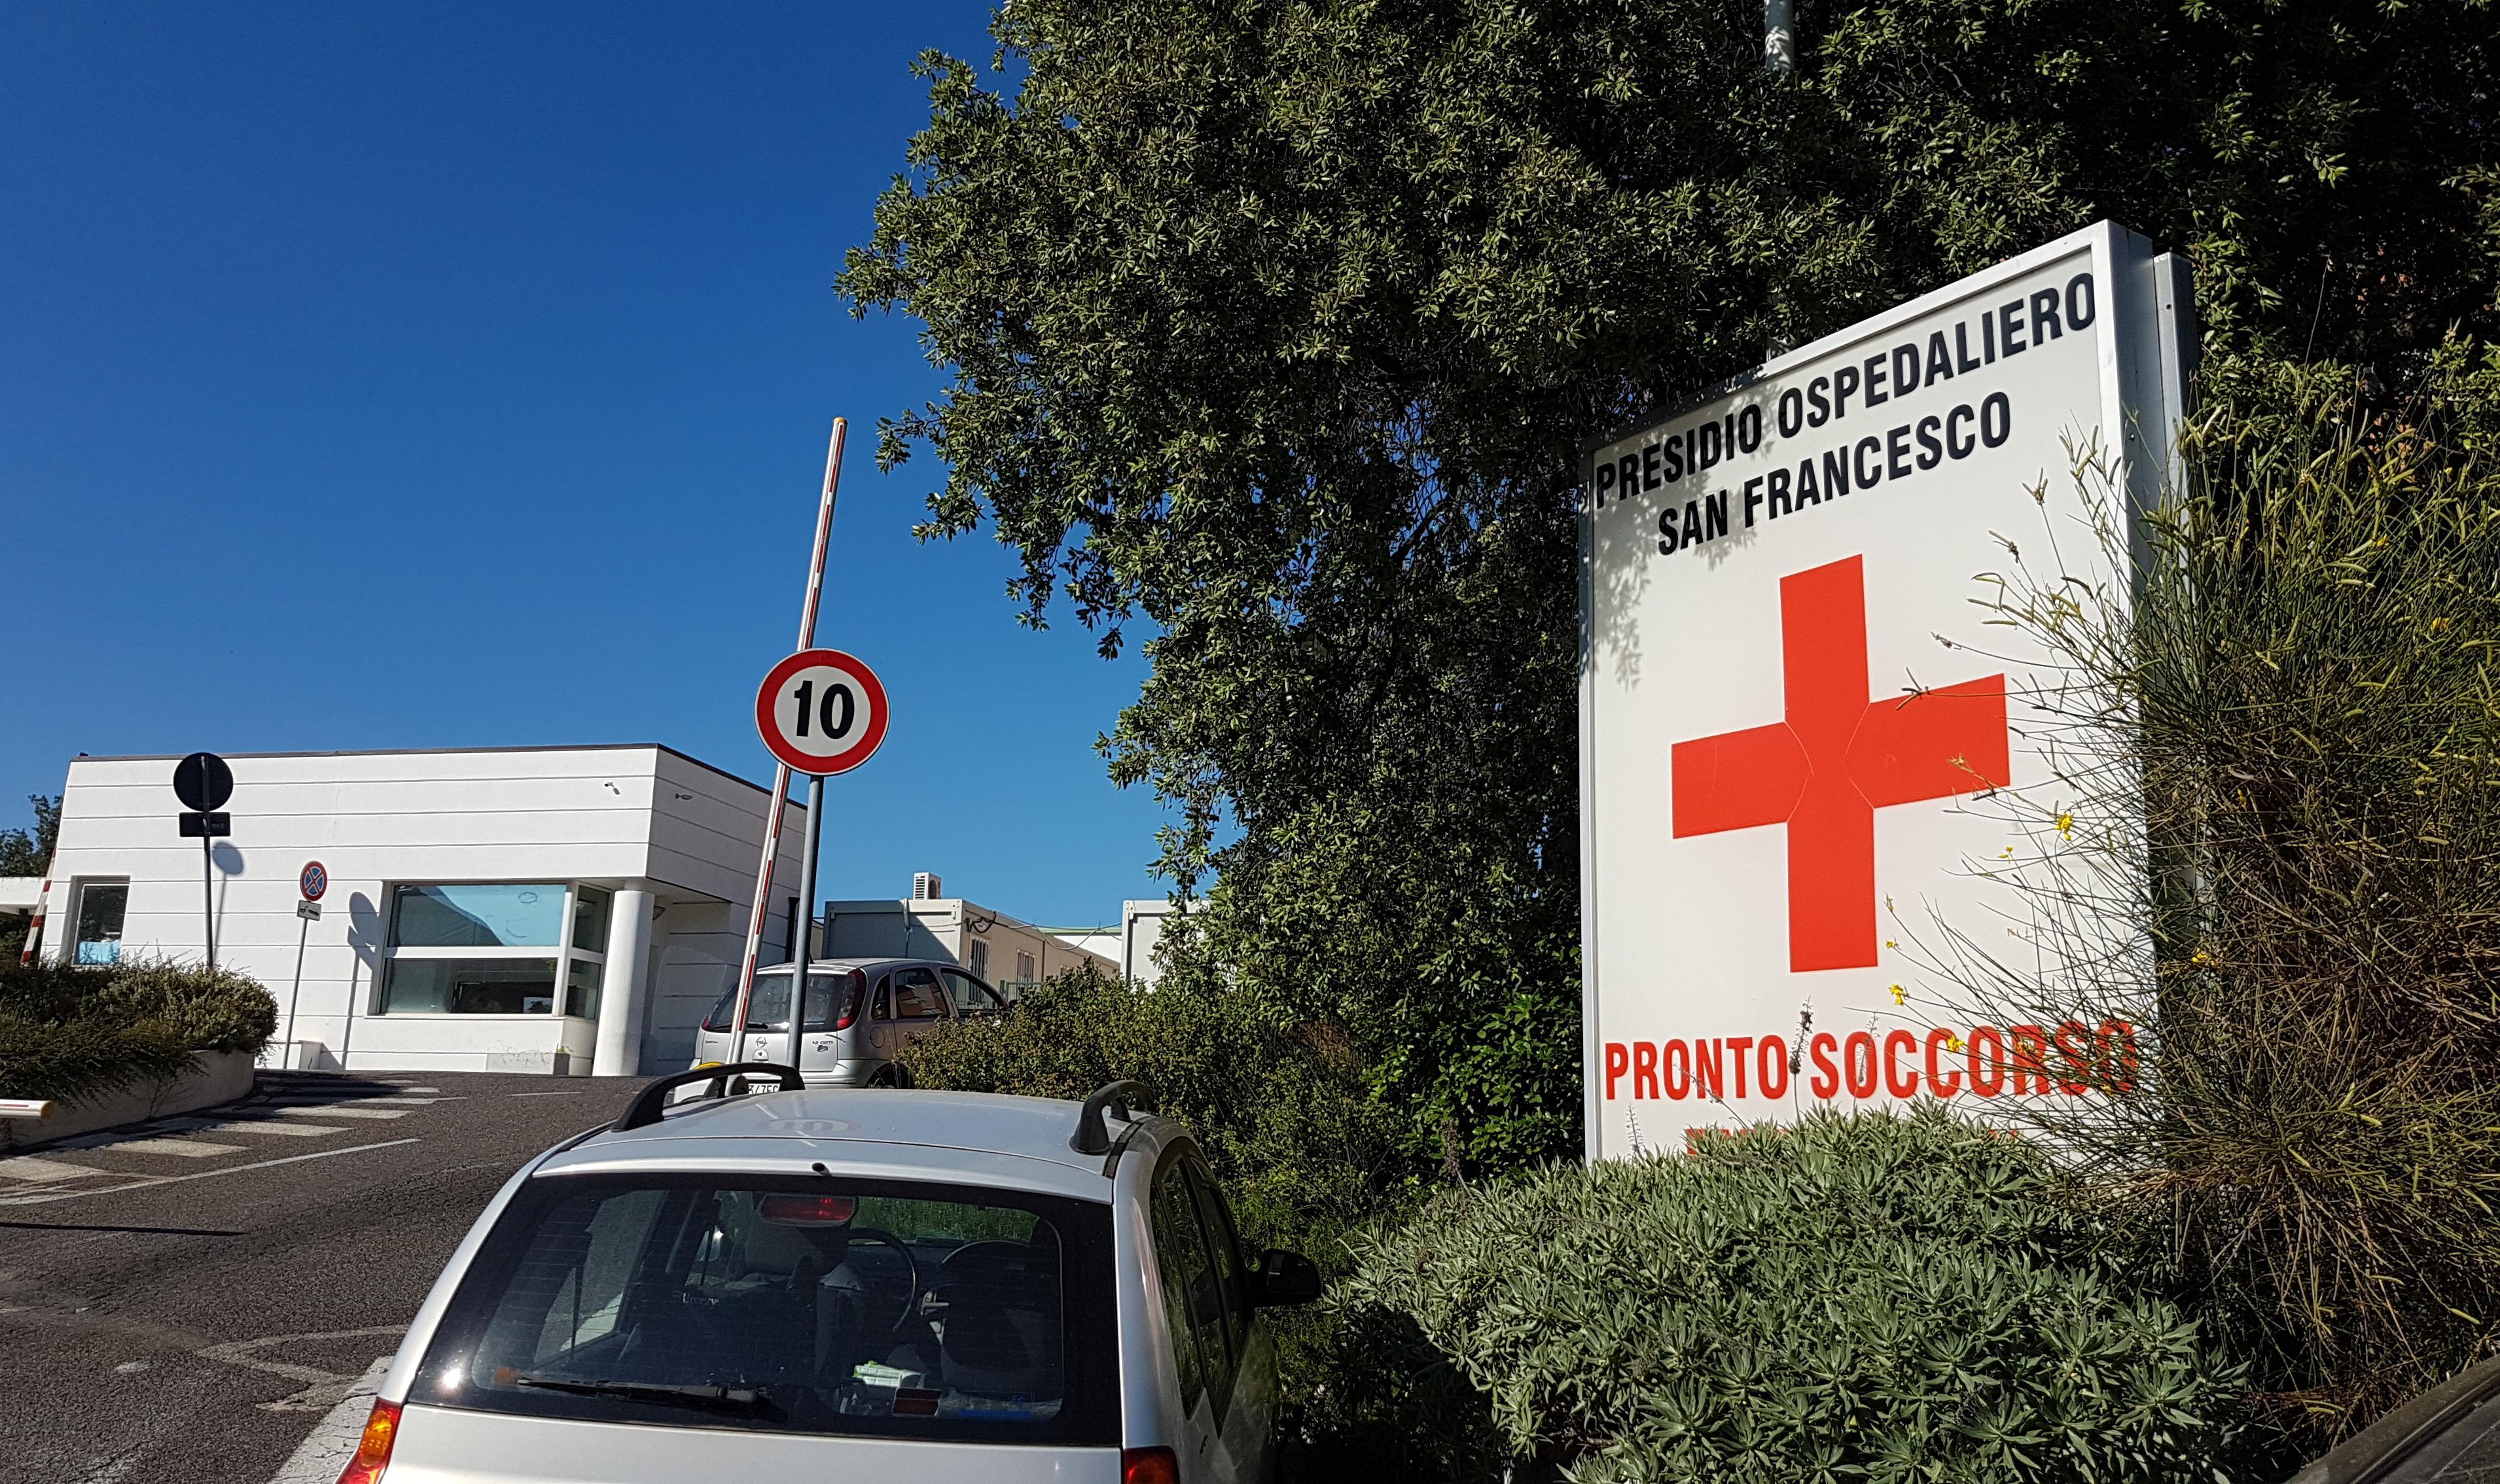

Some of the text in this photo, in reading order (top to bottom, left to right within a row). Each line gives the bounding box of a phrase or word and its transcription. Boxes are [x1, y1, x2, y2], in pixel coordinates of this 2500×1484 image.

[1595, 272, 2096, 510] PRESIDIO OSPEDALIERO
[1658, 391, 2011, 556] SAN FRANCESCO
[794, 680, 855, 739] 10
[1605, 1019, 2138, 1101] PRONTO SOCCORSO
